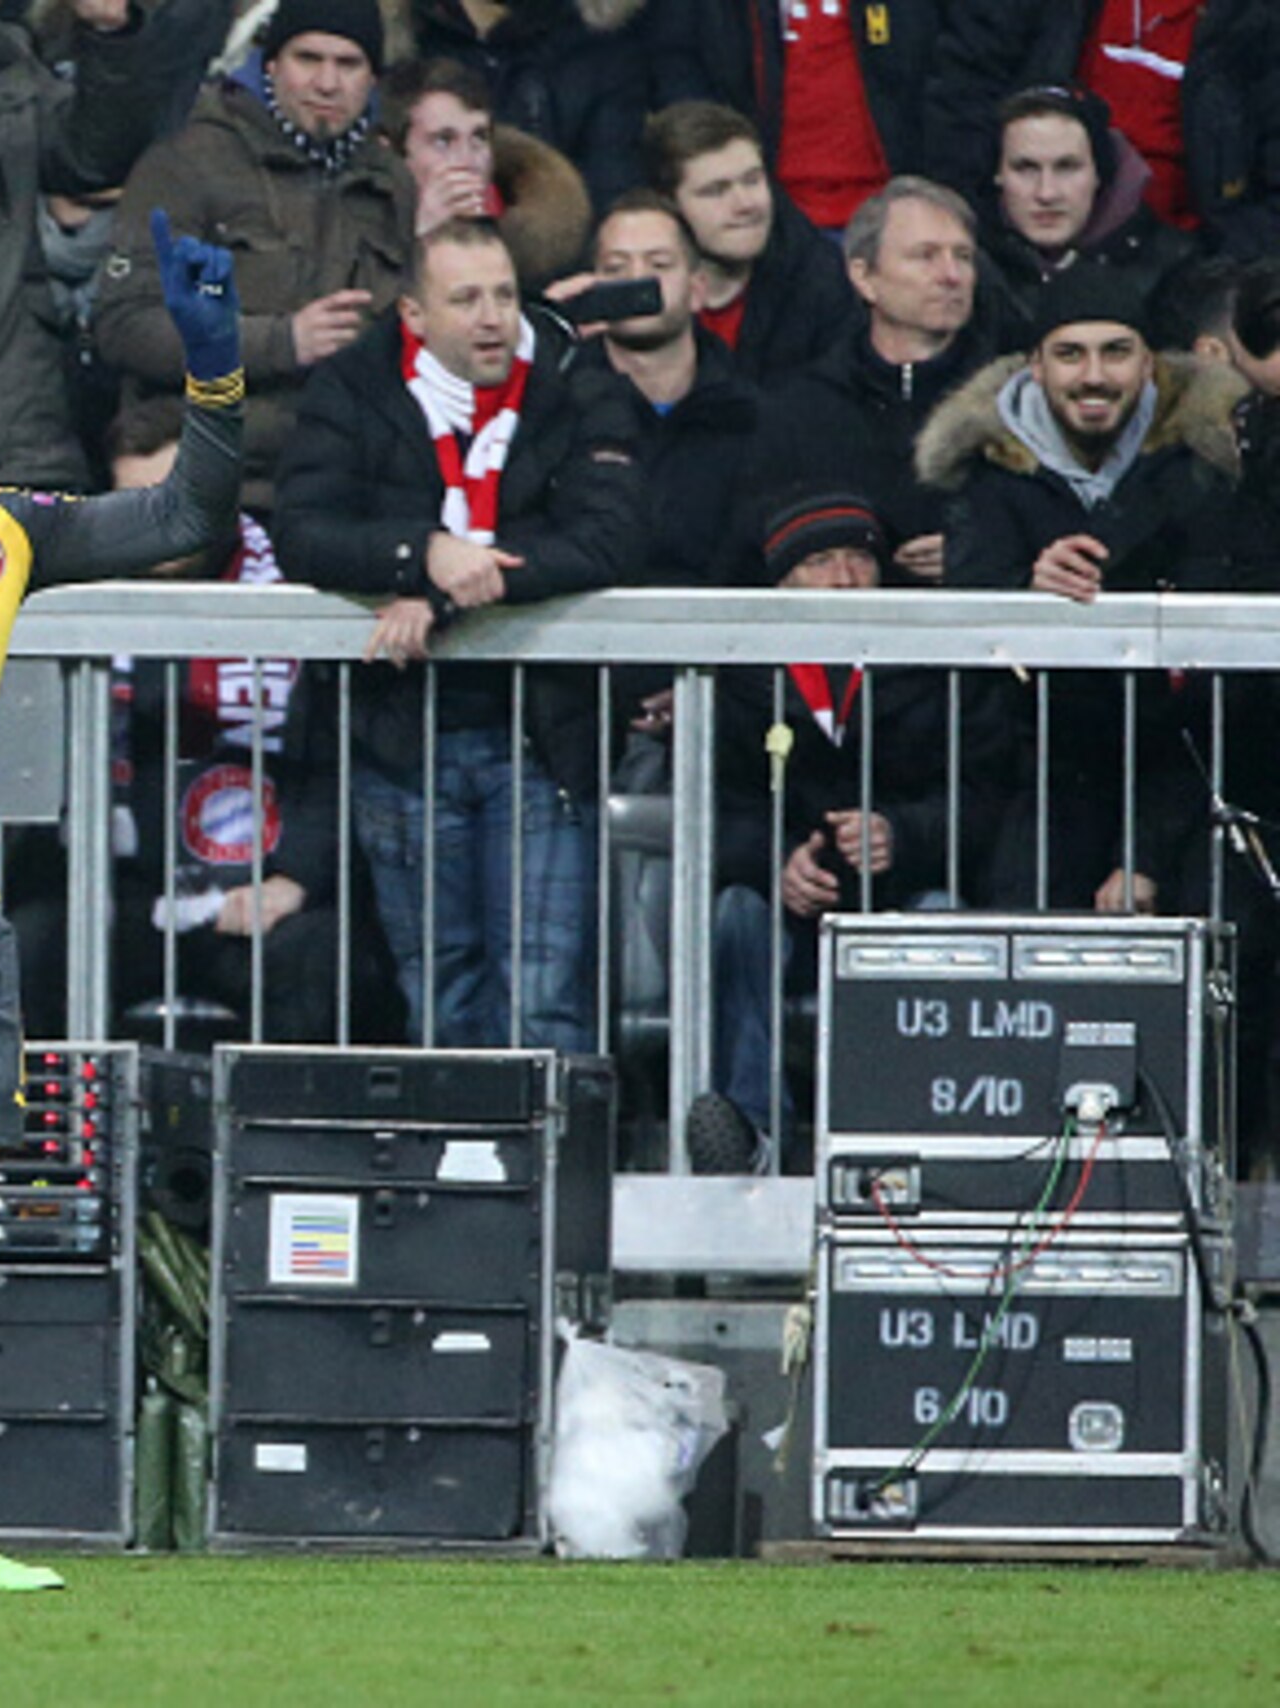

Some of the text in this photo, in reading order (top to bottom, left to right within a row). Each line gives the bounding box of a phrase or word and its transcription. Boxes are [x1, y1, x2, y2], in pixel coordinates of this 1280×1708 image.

[896, 999, 1054, 1038] U3 LMD
[930, 1076, 1024, 1117] 8/10
[878, 1309, 935, 1348] U3
